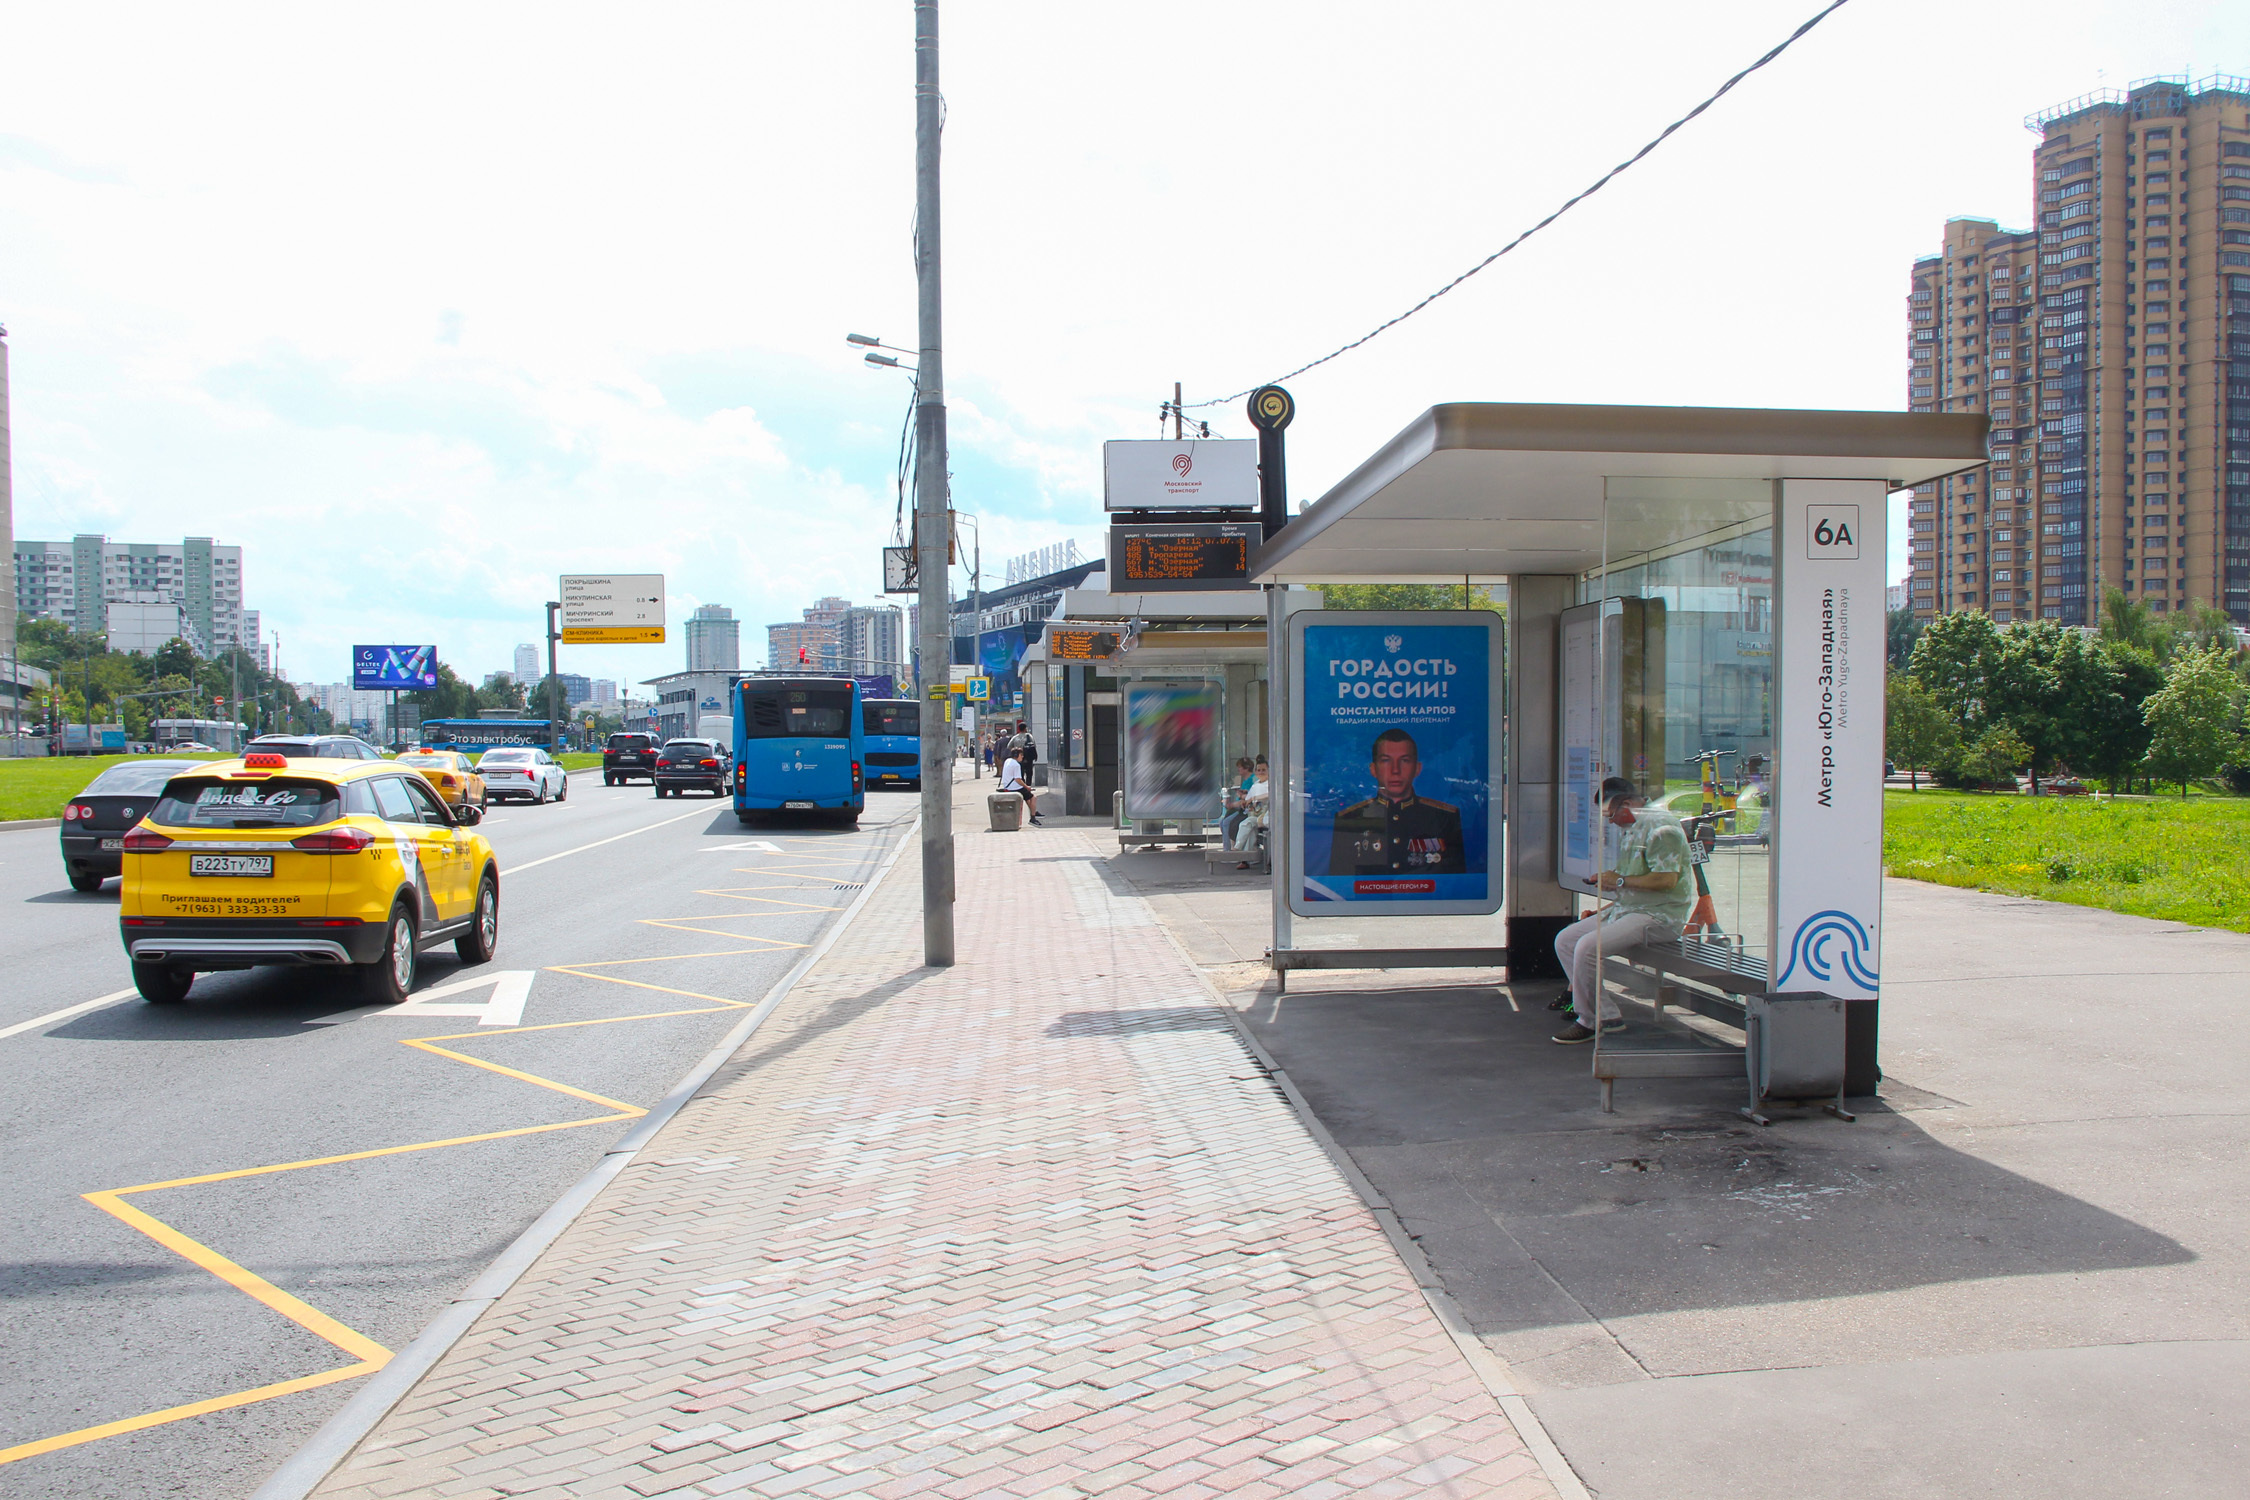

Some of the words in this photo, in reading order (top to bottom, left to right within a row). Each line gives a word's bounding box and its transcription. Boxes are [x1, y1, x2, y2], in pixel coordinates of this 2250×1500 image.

[1149, 551, 1194, 559] Тропарево
[1837, 587, 1850, 689] Yugo-Zapadnaya
[1329, 659, 1457, 678] ГОРДОСТЬ
[1818, 587, 1835, 740] «Юго-Западная»
[1338, 681, 1448, 698] РОССИИ!
[1330, 706, 1407, 716] КОНСТАНТИН
[1410, 705, 1456, 715] КАРПОВ
[1837, 691, 1848, 729] Metro
[1336, 717, 1369, 725] ГВАРДИИ
[1370, 715, 1409, 724] МЛАДШИЙ
[1410, 715, 1451, 724] ЛЕЙТЕНАНТ
[449, 733, 469, 744] Это
[470, 733, 535, 746] электробус.
[1817, 745, 1835, 808] Метро
[198, 792, 265, 805] Яндекс
[265, 790, 298, 806] Go
[196, 858, 246, 871] В223ТУ
[248, 857, 268, 868] 797
[161, 894, 232, 904] Приглашаем
[236, 895, 301, 905] водителей
[227, 905, 287, 914] 333-33-33
